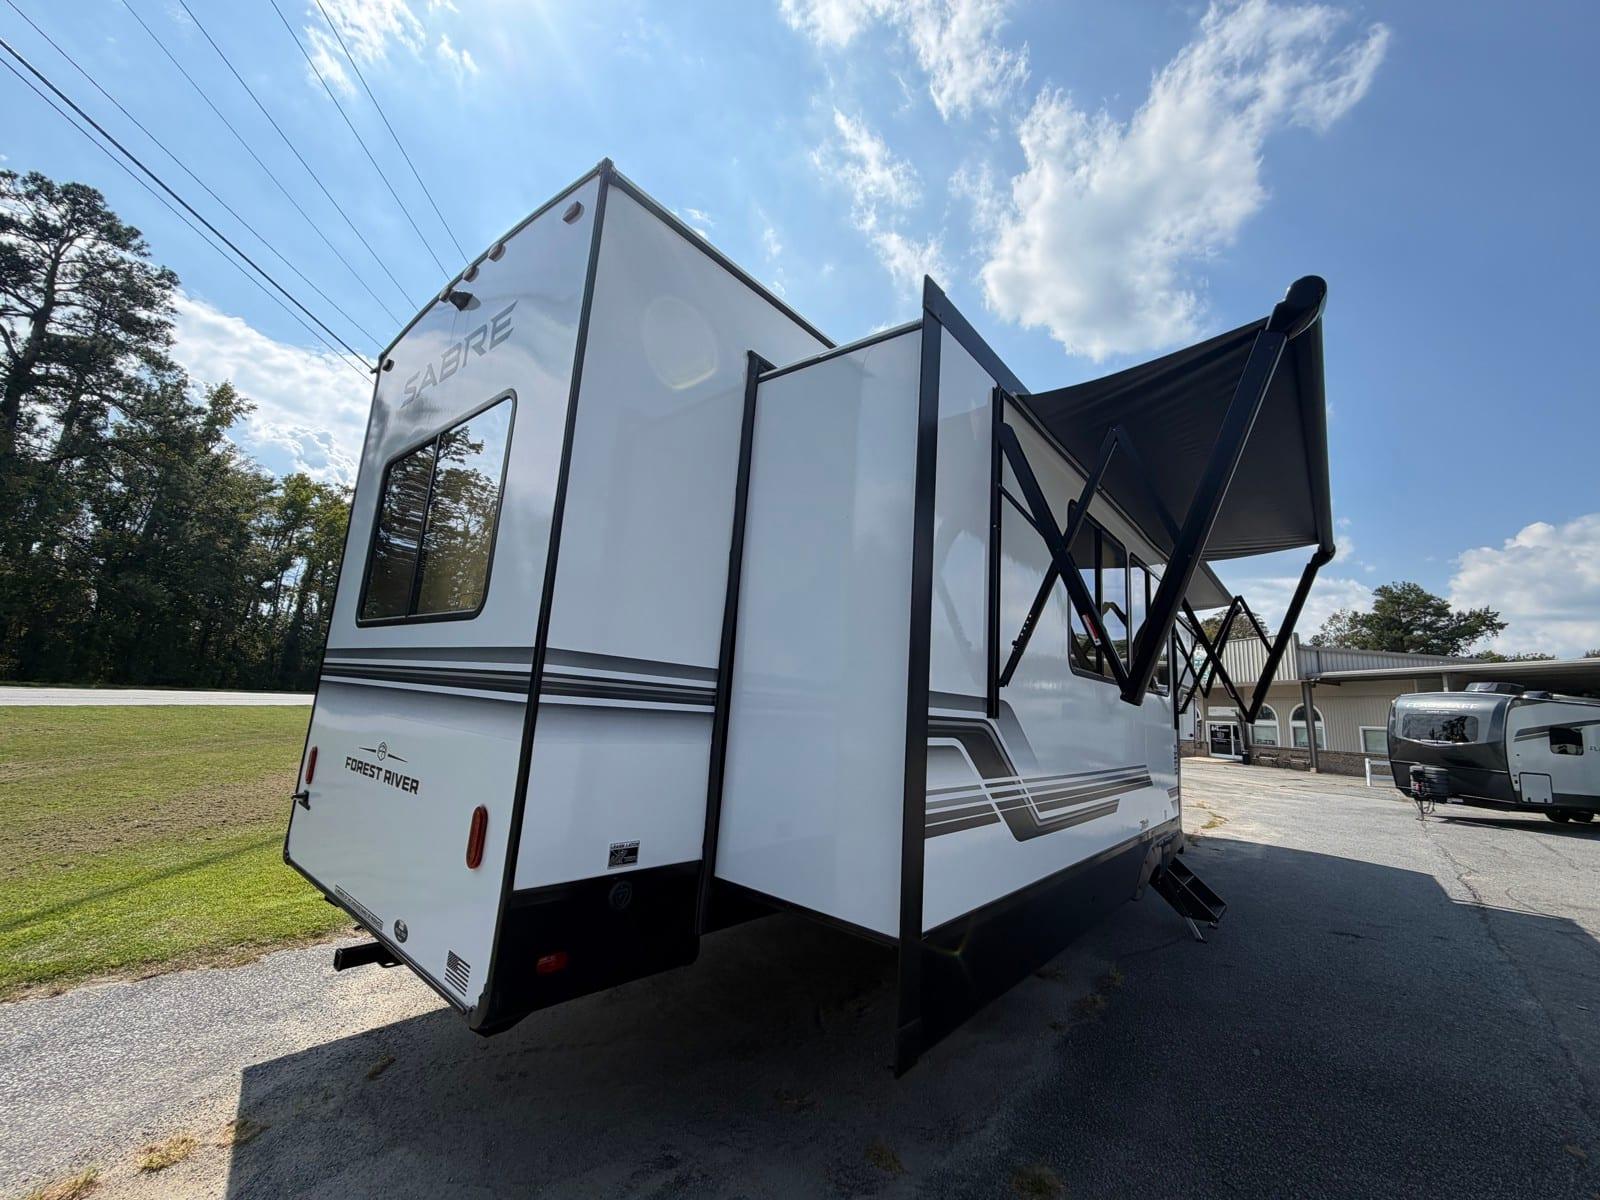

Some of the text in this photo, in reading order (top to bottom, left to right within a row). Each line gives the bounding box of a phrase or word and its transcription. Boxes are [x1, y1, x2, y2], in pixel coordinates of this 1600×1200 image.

[400, 299, 519, 409] SABRE
[345, 756, 419, 795] FOREST RIVER
